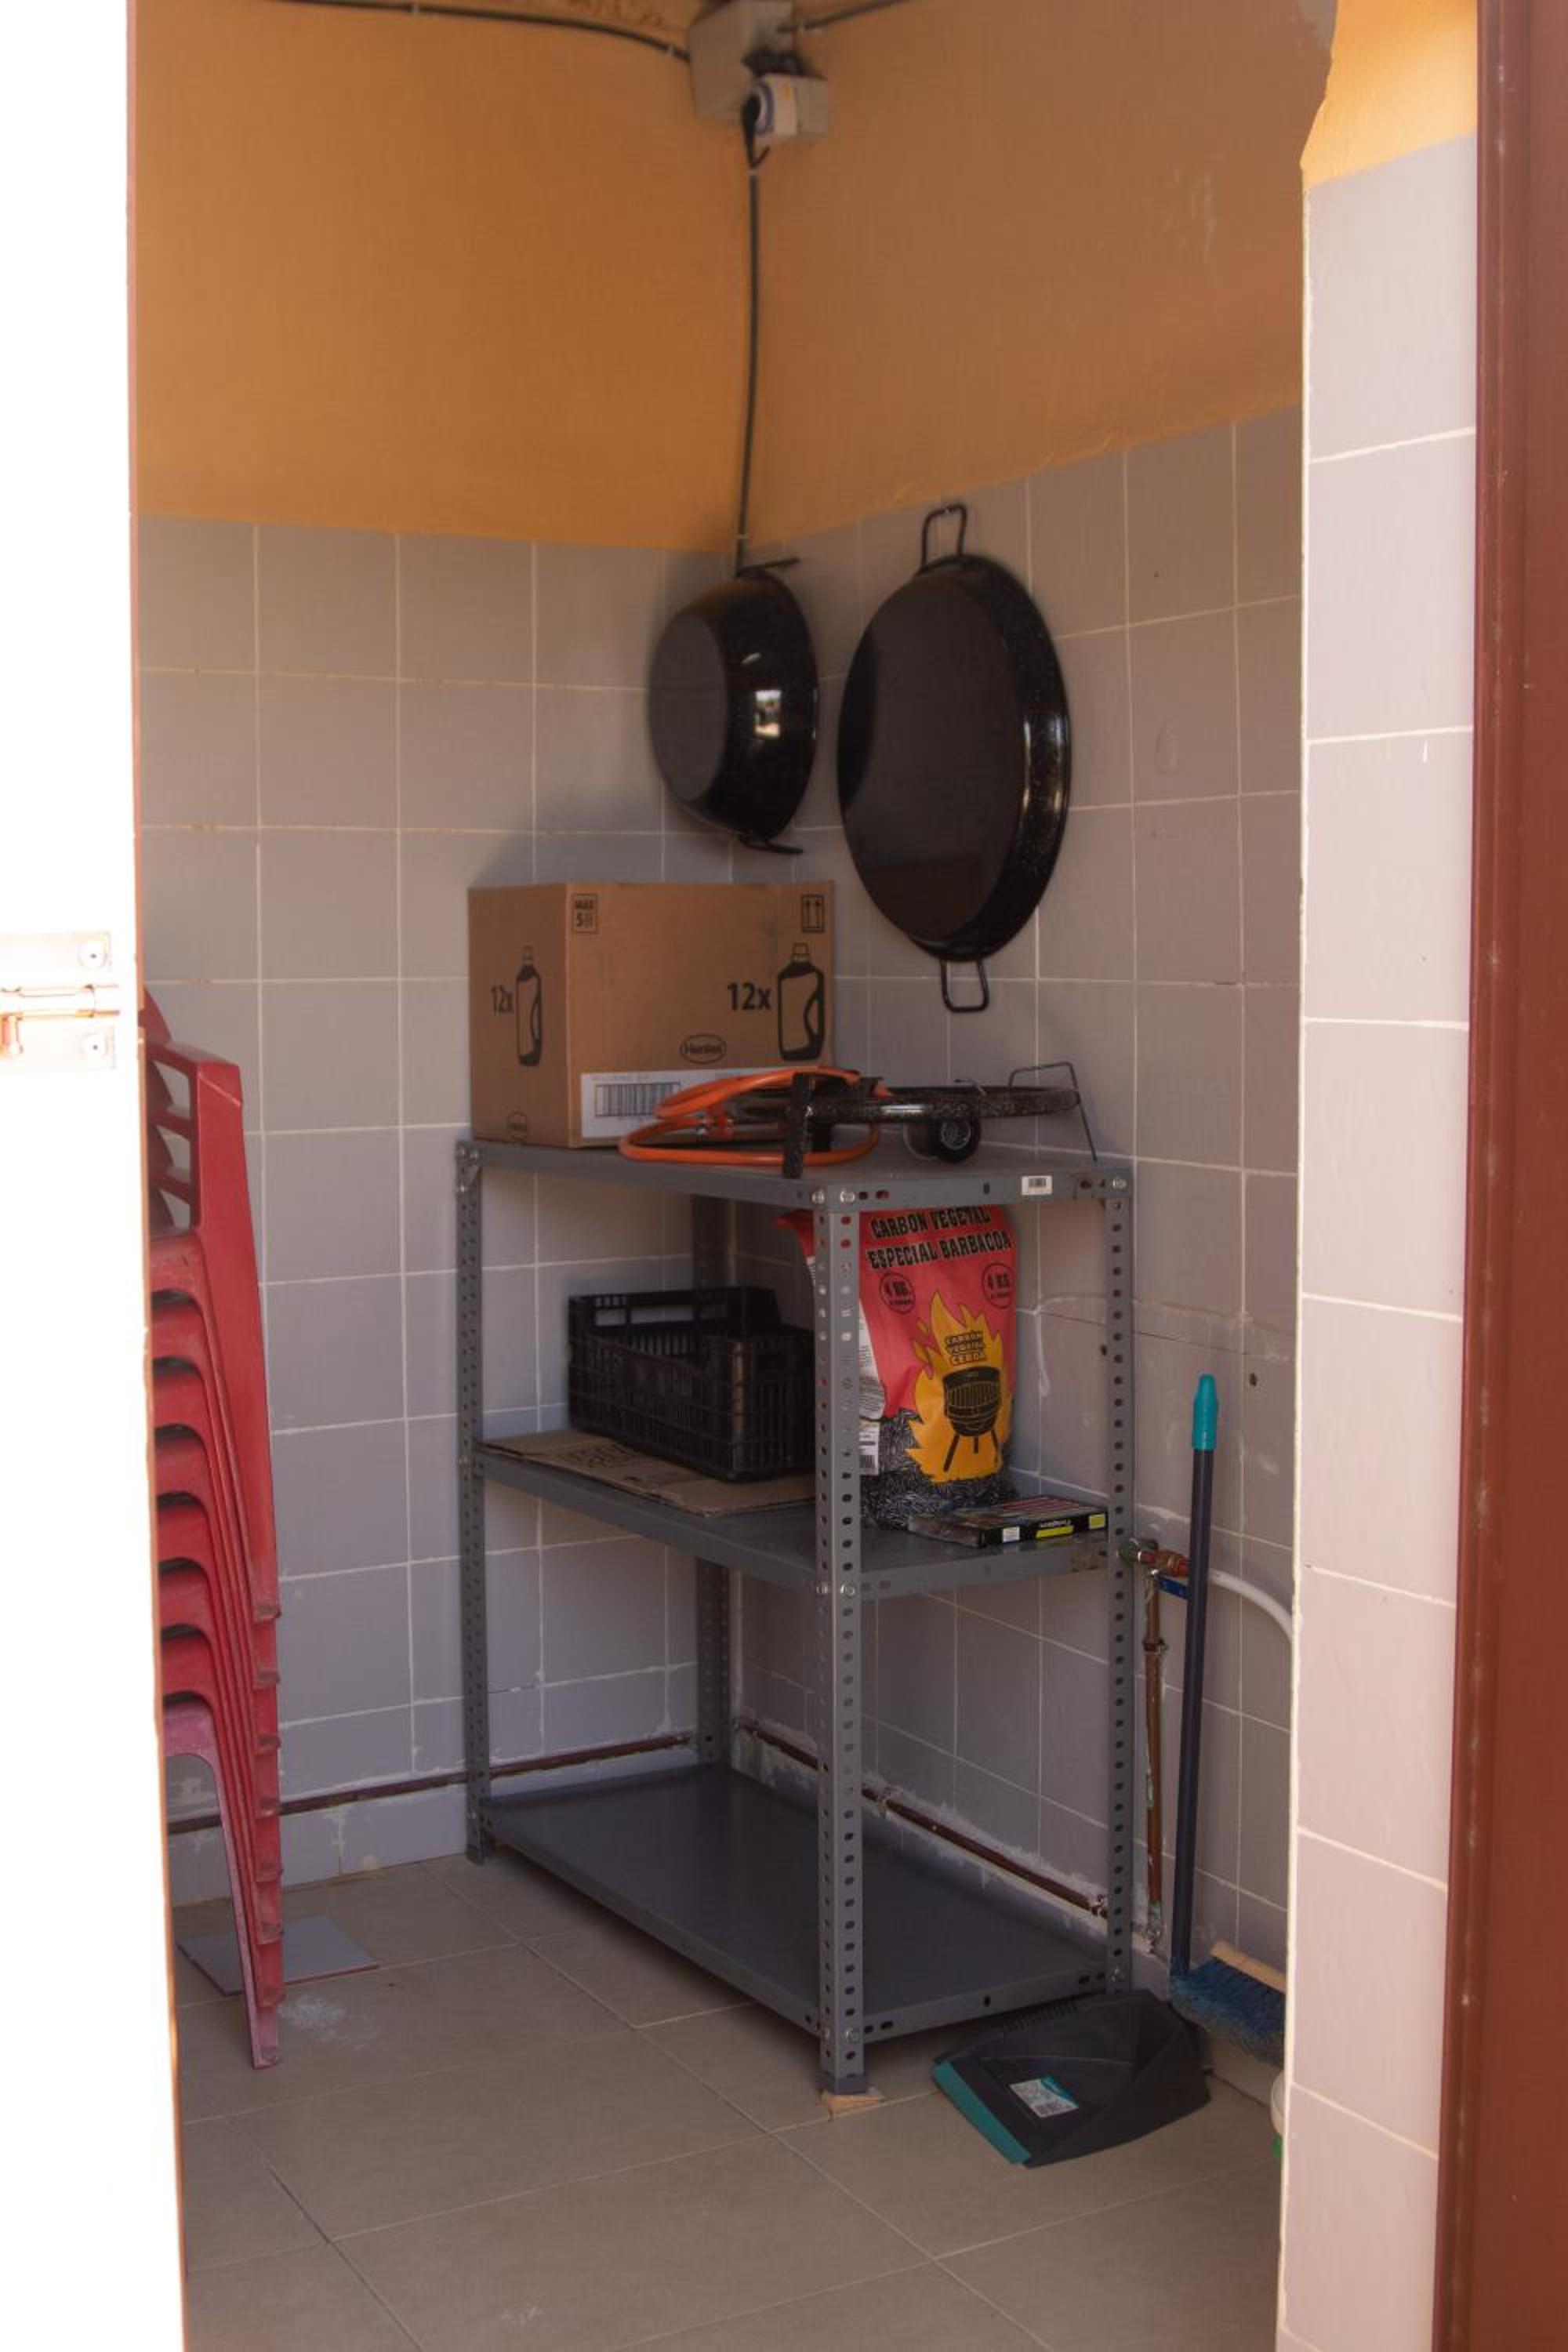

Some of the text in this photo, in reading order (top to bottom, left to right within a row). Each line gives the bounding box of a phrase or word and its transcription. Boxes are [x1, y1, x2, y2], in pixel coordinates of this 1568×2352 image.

[492, 985, 514, 1014] 12x
[727, 982, 771, 1011] 12x
[929, 1205, 992, 1230] VEGETAL
[867, 1230, 1012, 1269] ESPECIAL BARBACOA
